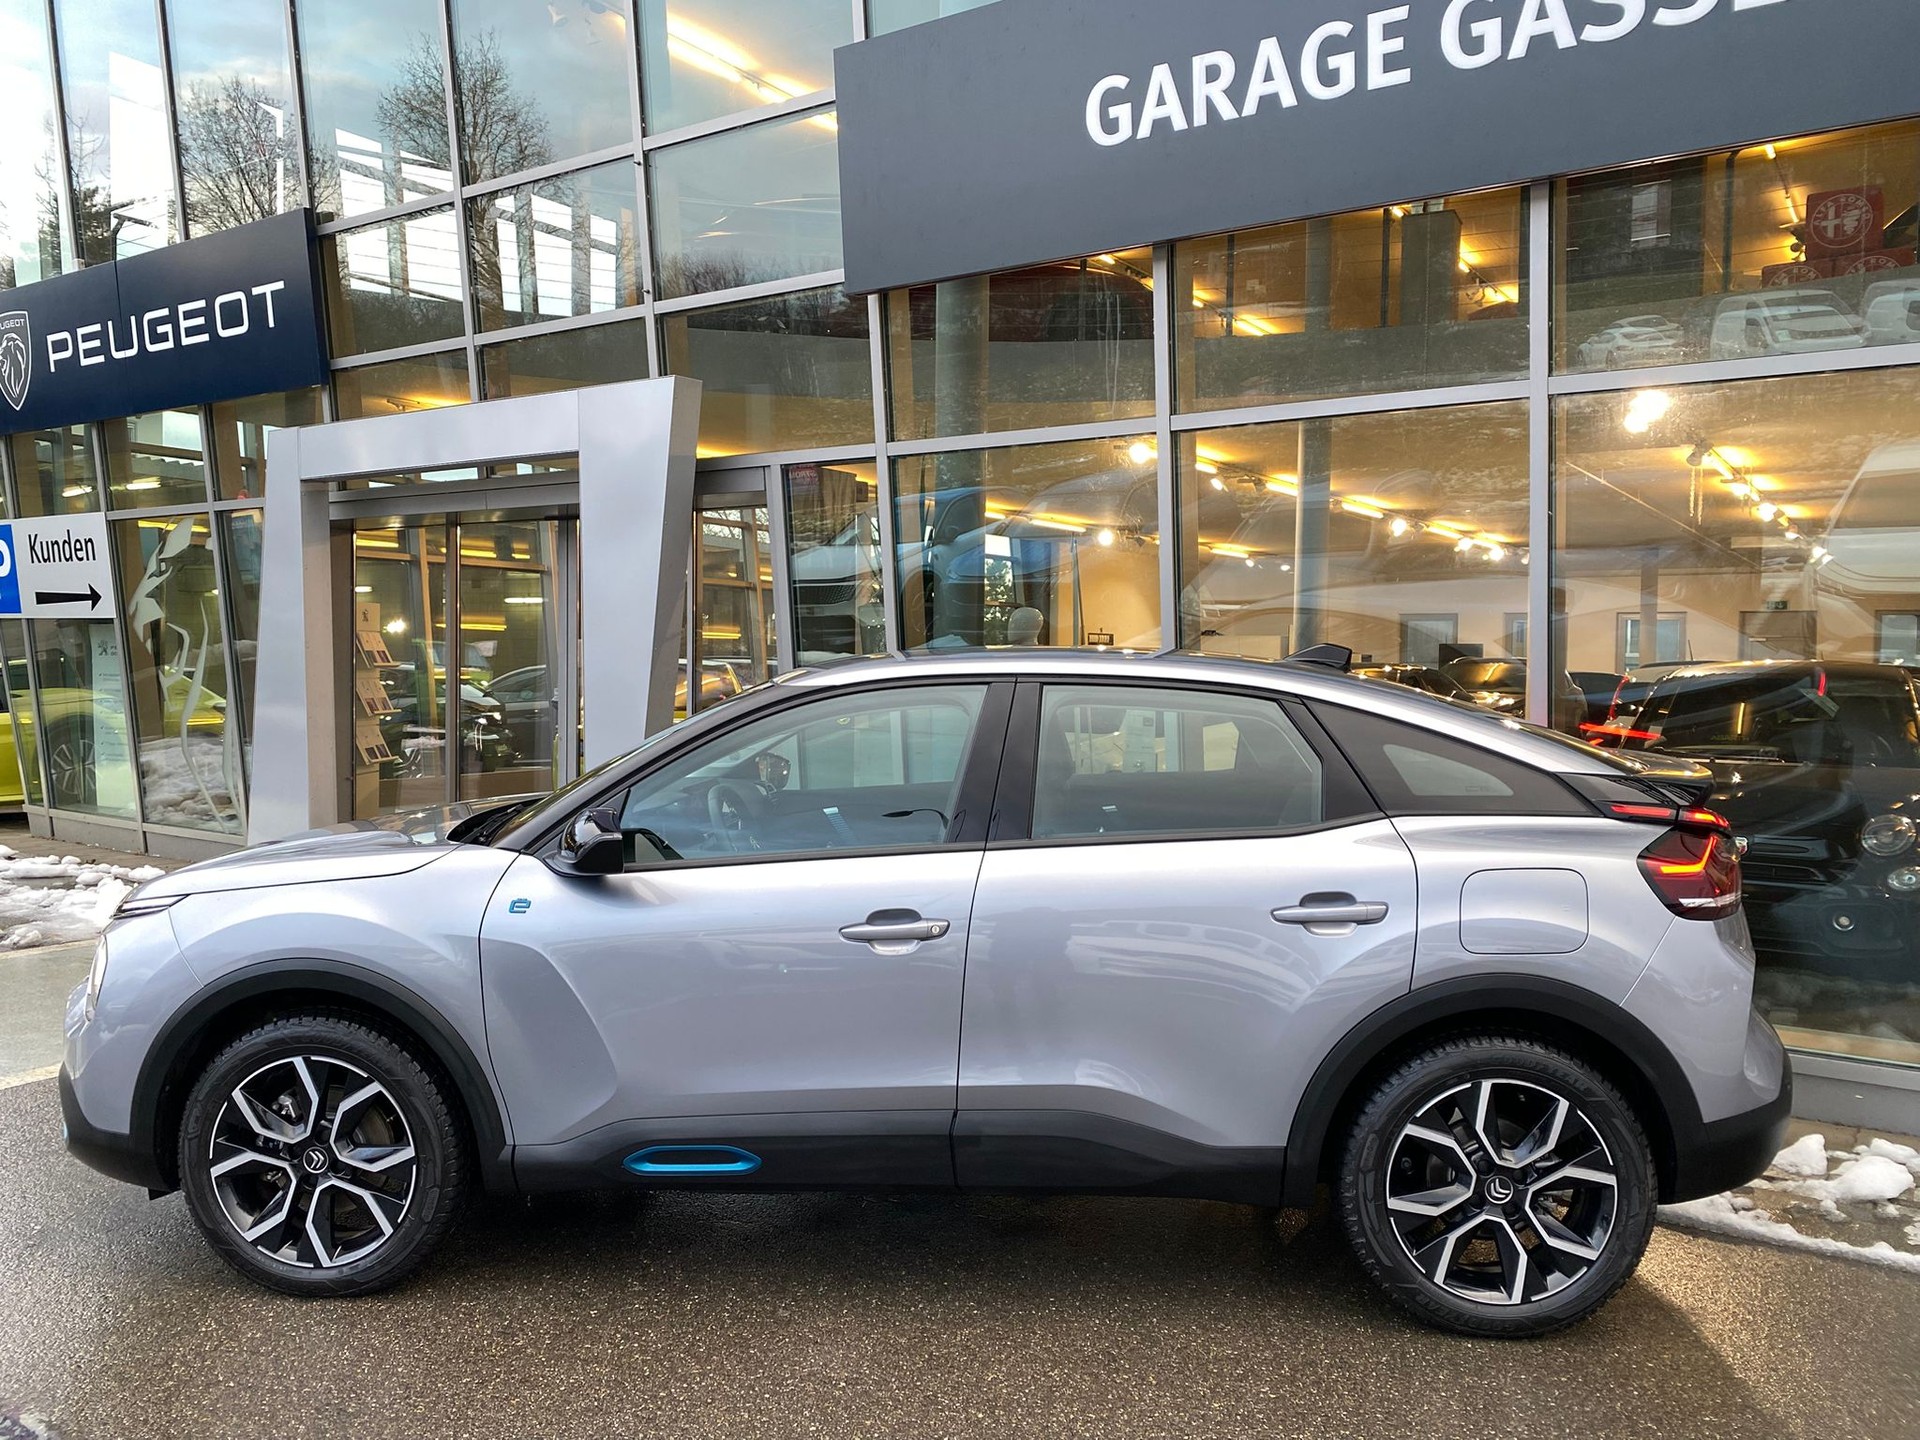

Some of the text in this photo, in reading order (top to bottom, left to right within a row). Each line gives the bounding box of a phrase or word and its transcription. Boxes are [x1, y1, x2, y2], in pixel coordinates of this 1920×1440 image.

[1085, 4, 1411, 147] GARAGE
[46, 280, 285, 373] PEUGEOT
[28, 529, 96, 564] Kunden
